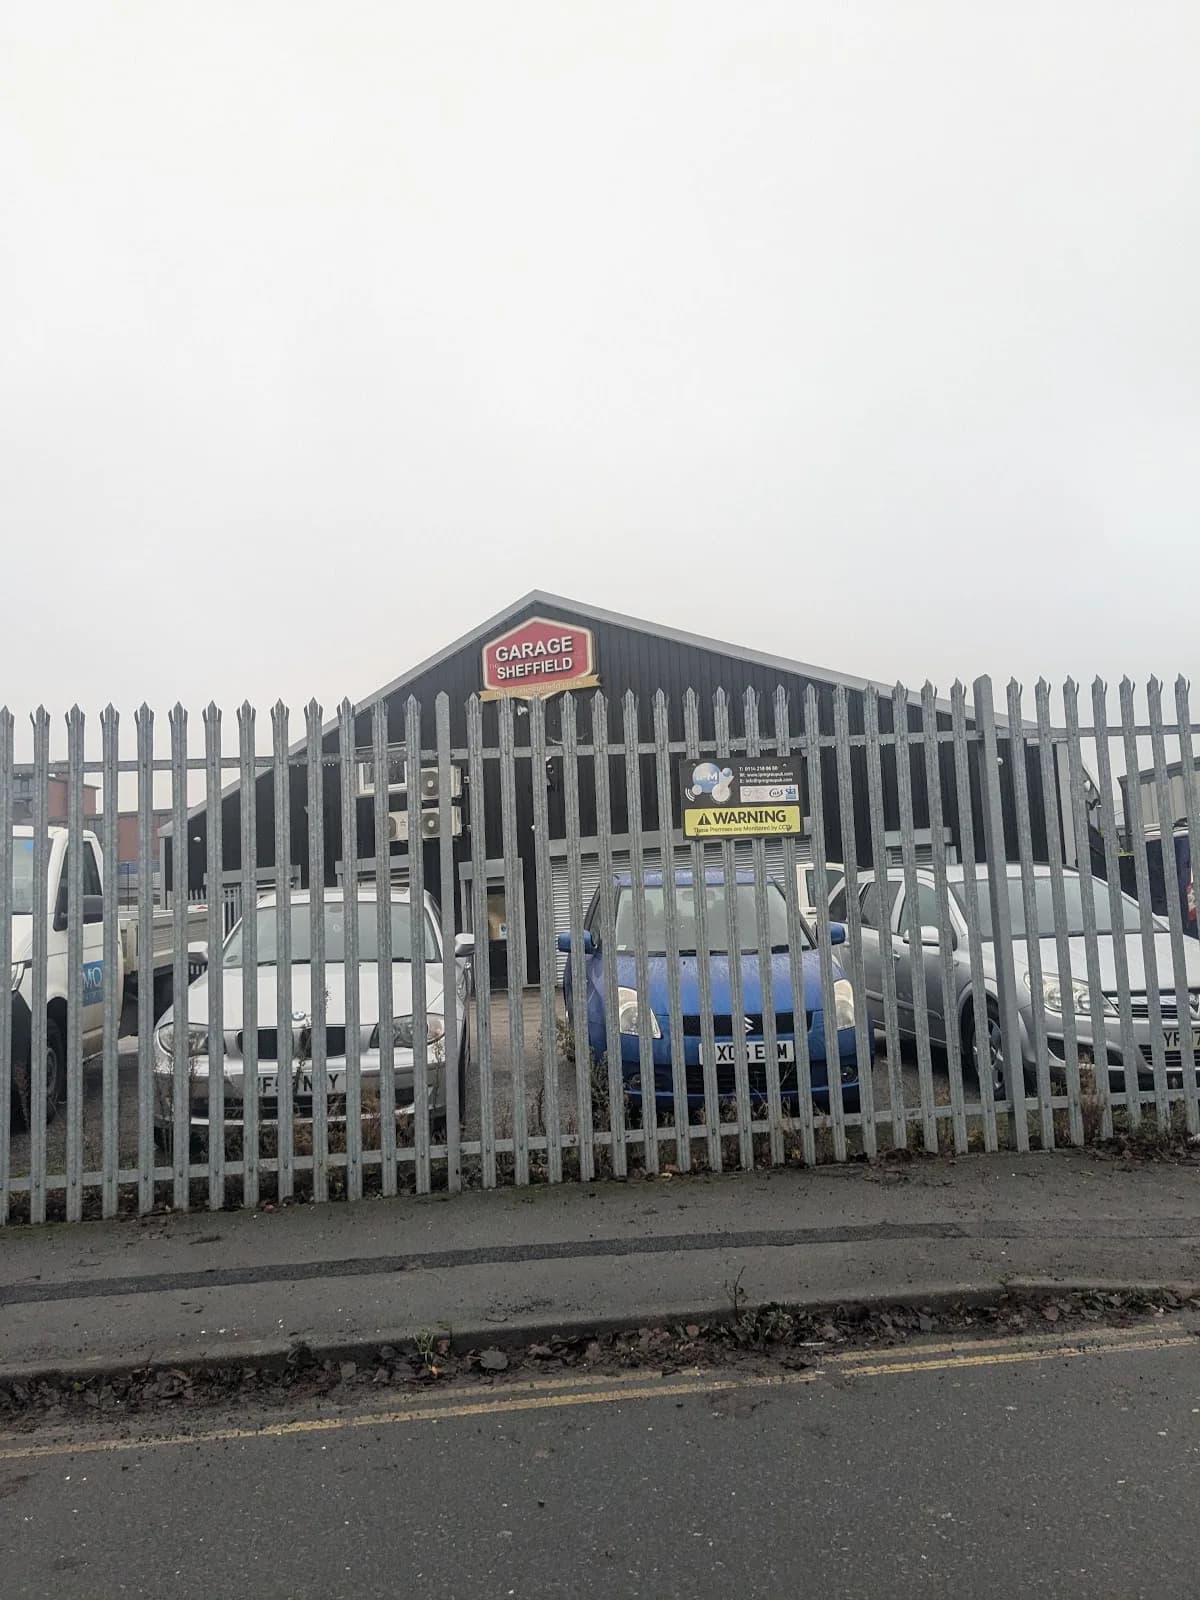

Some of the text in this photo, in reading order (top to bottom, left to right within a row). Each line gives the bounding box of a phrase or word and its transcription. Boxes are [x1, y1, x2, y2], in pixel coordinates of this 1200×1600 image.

[495, 636, 574, 662] GARAGE
[496, 657, 573, 680] SHEFFIELD
[712, 810, 786, 825] WARNING
[755, 1043, 787, 1060] EM
[303, 1073, 339, 1092] NY
